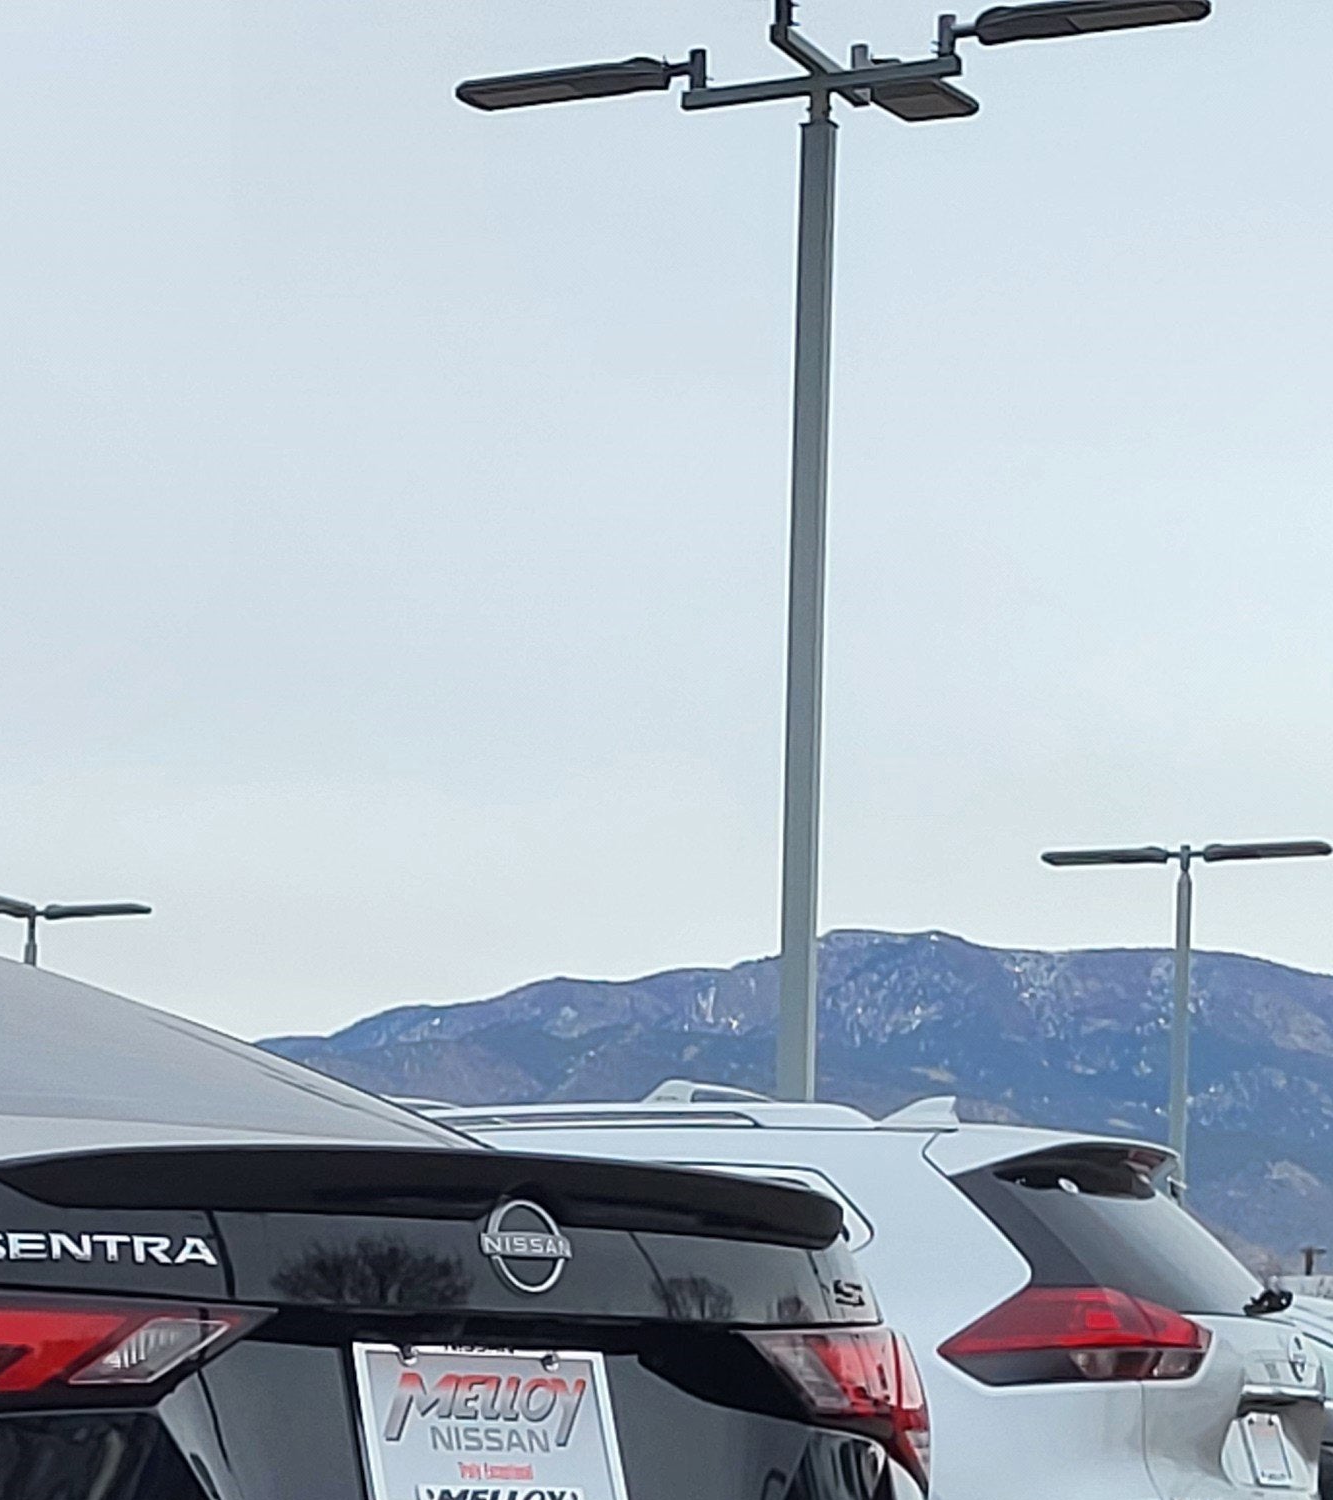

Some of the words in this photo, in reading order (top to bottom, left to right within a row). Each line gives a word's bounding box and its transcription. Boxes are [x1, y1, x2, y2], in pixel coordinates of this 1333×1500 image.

[482, 1235, 572, 1258] NISSAN
[384, 1371, 587, 1448] MELLOY
[429, 1425, 551, 1453] NISSAN
